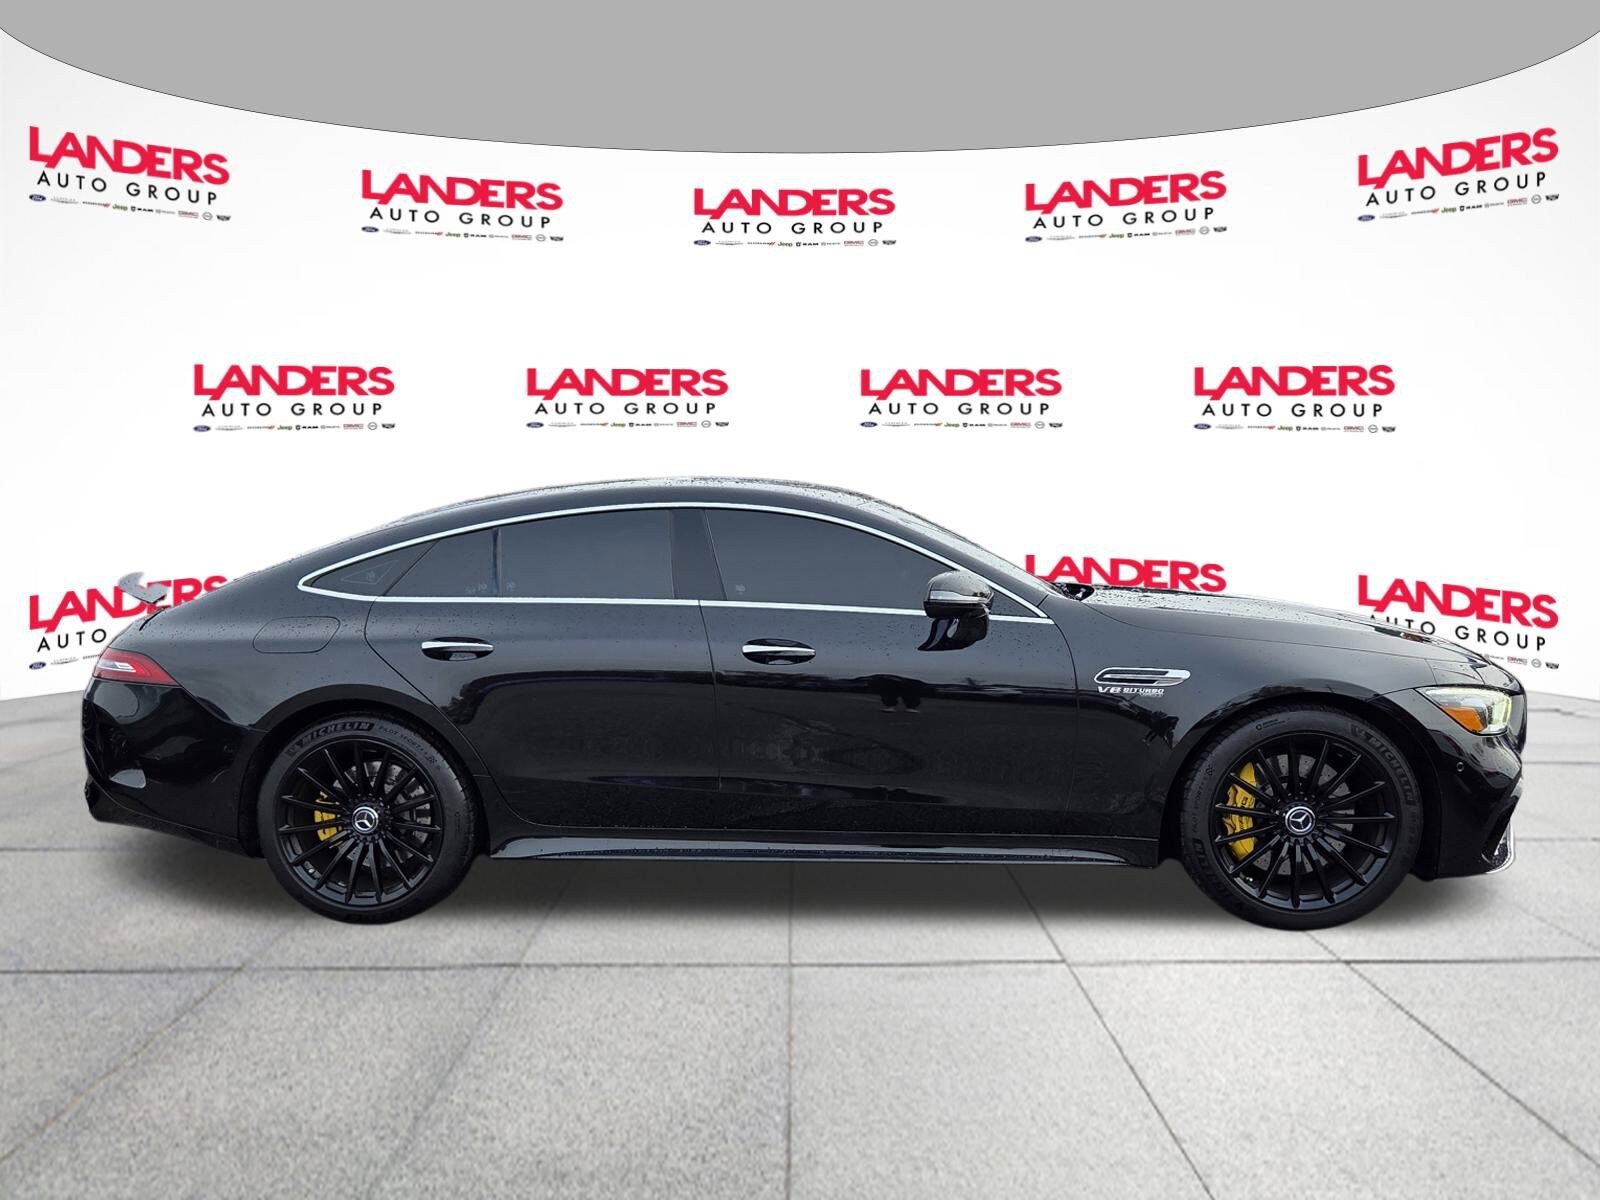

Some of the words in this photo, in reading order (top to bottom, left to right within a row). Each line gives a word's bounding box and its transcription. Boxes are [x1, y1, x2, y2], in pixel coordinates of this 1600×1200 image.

[29, 126, 230, 185] LANDERS
[1358, 128, 1559, 189] LANDERS
[37, 171, 106, 192] AUTO
[126, 182, 217, 206] GROUP
[362, 170, 563, 210] LANDERS
[694, 188, 895, 220] LANDERS
[1025, 171, 1227, 214] LANDERS
[1366, 186, 1435, 206] AUTO
[1455, 172, 1546, 195] GROUP
[370, 207, 439, 223] AUTO
[459, 213, 550, 229] GROUP
[702, 222, 771, 234] AUTO
[792, 222, 883, 234] GROUP
[1033, 215, 1103, 229] AUTO
[1123, 208, 1214, 224] GROUP
[194, 364, 395, 400] LANDERS
[527, 368, 728, 400] LANDERS
[861, 369, 1062, 400] LANDERS
[1194, 365, 1395, 400] LANDERS
[202, 403, 271, 416] AUTO
[291, 403, 382, 416] GROUP
[535, 403, 604, 414] AUTO
[624, 403, 715, 414] GROUP
[869, 403, 938, 415] AUTO
[958, 403, 1049, 415] GROUP
[1202, 403, 1271, 417] AUTO
[1291, 404, 1382, 417] GROUP
[1025, 555, 1226, 592] LANDERS
[1358, 575, 1559, 630] LANDERS
[37, 629, 106, 652] AUTO
[1370, 614, 1435, 636] UTO
[1455, 626, 1546, 651] GROUP
[1097, 686, 1121, 694] V8
[301, 721, 371, 742] MICHELIN
